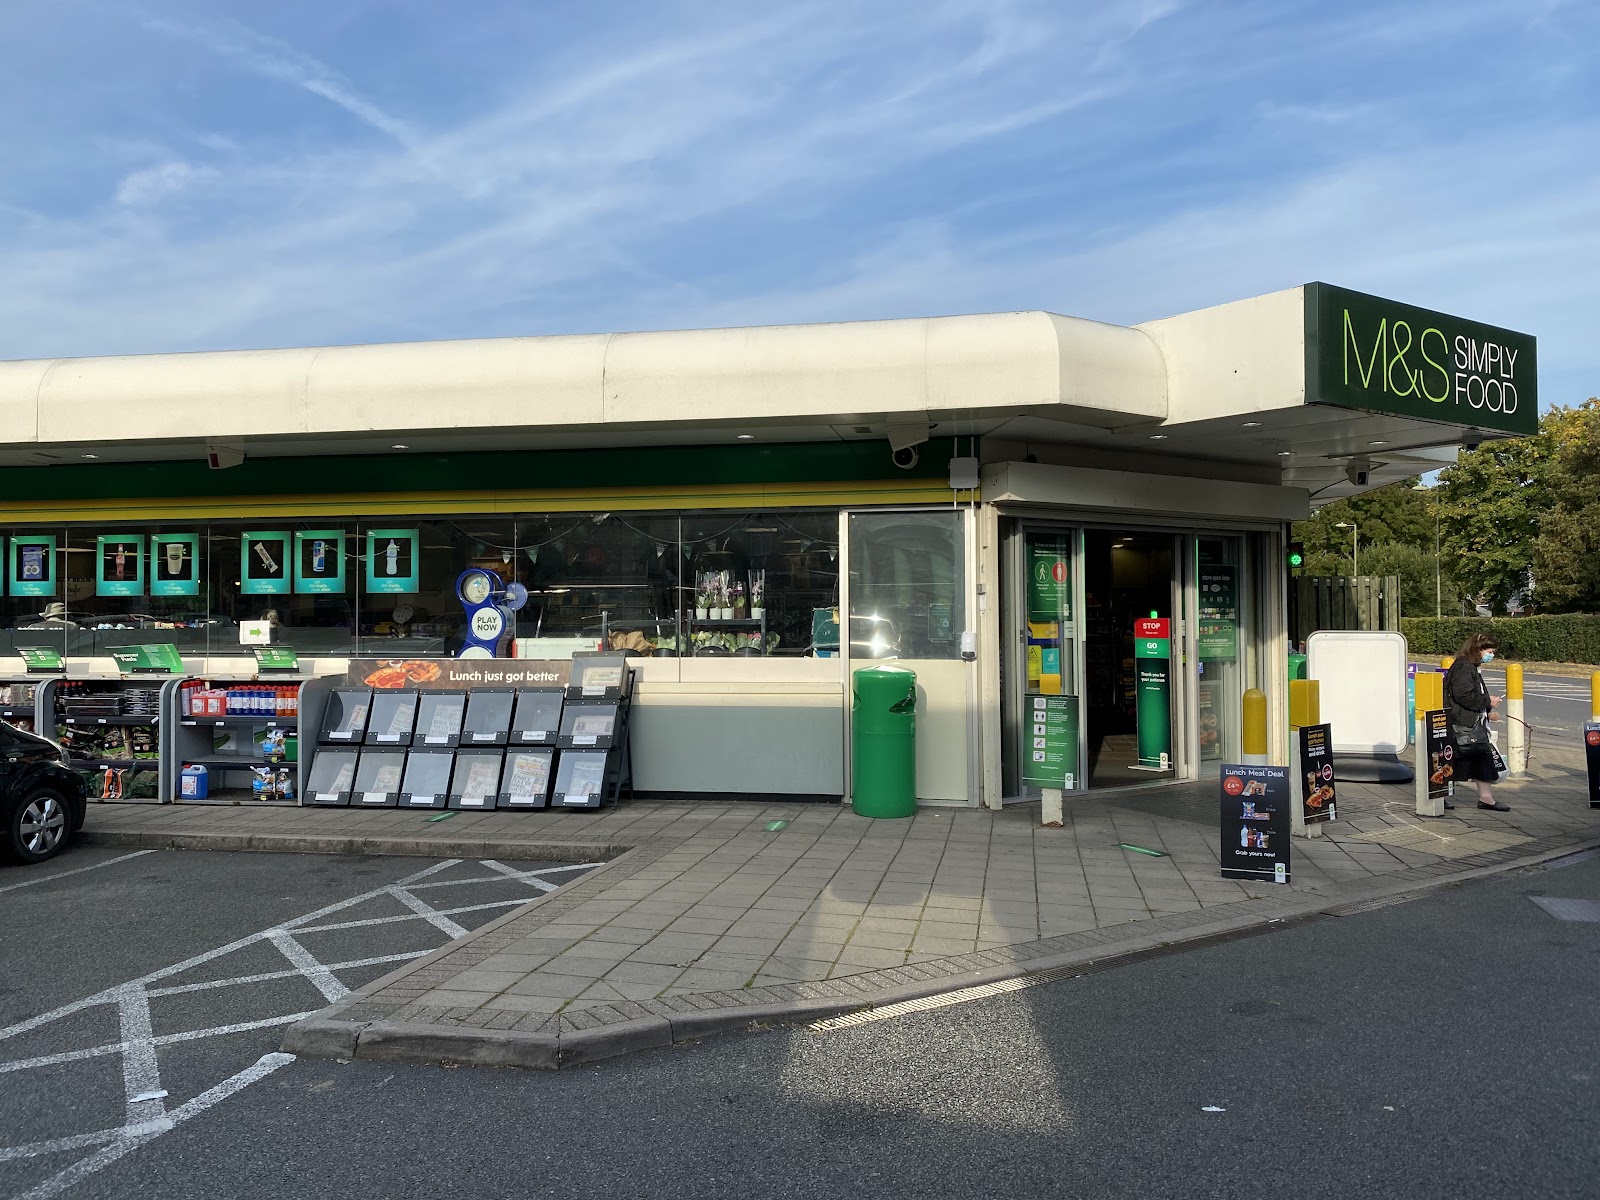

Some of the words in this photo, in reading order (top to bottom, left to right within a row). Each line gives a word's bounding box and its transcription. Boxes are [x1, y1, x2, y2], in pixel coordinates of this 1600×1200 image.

[1343, 309, 1450, 403] M&S
[1454, 335, 1518, 379] SIMPLY
[1455, 372, 1518, 414] FOOD
[450, 670, 482, 680] Lunch
[484, 670, 504, 683] just
[506, 672, 524, 683] got
[526, 670, 560, 681] better
